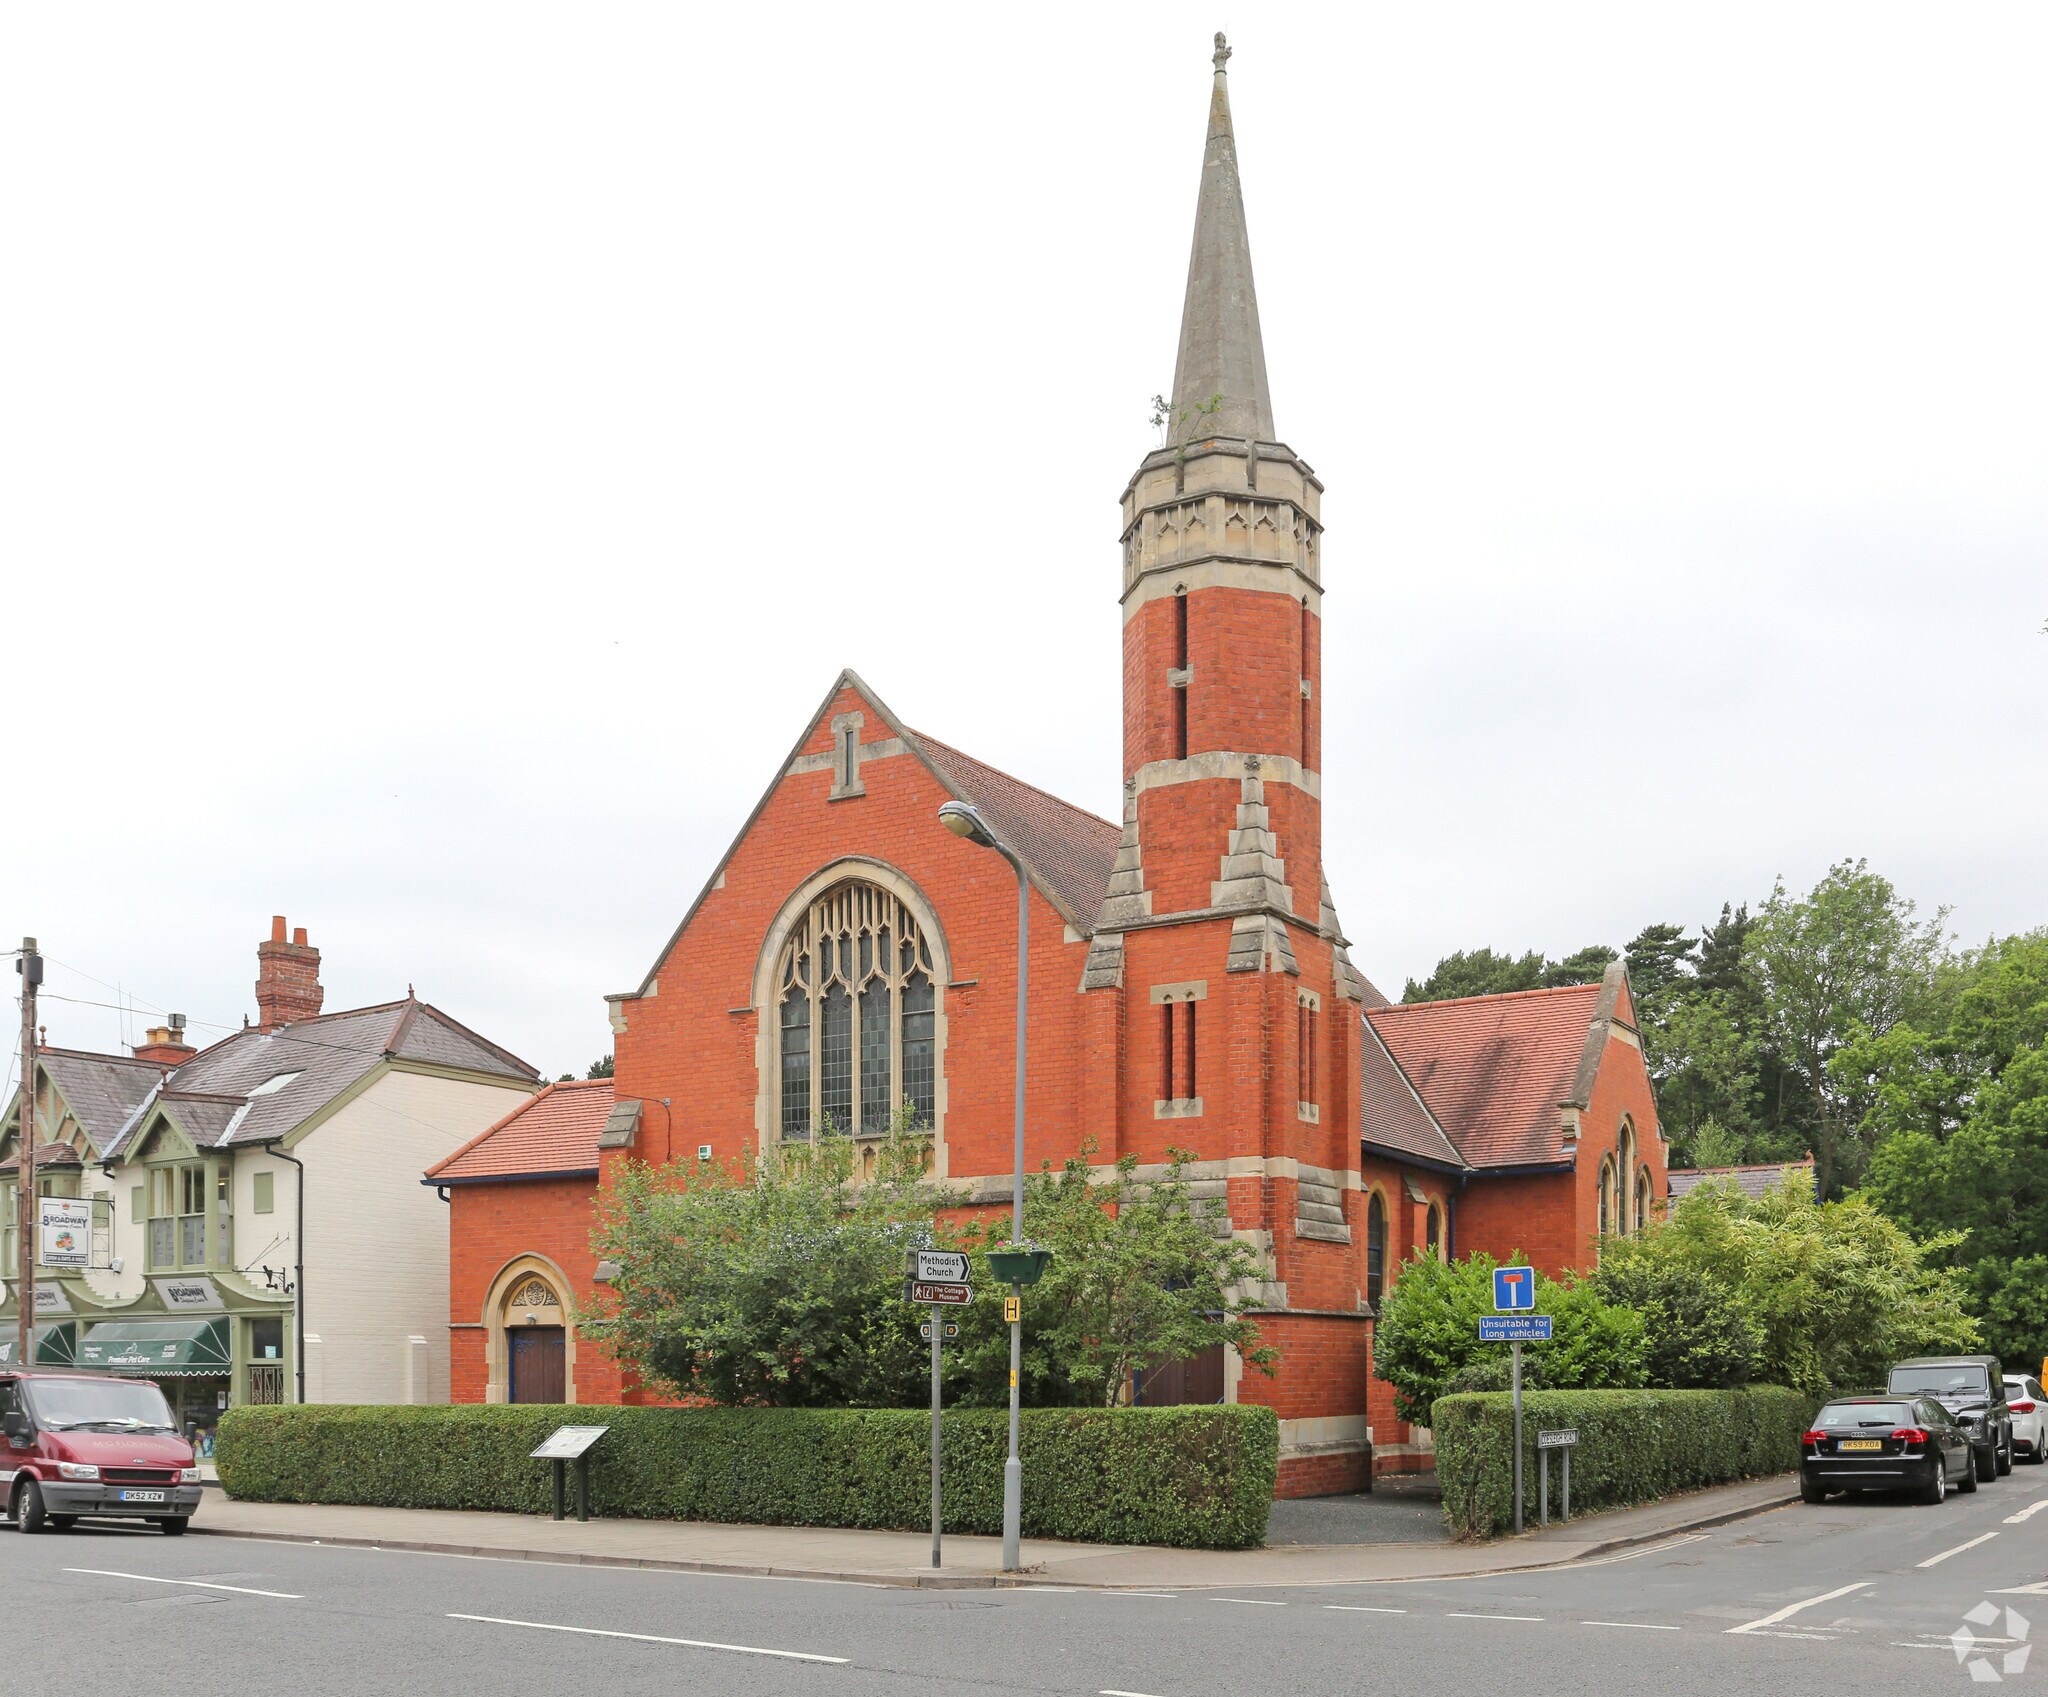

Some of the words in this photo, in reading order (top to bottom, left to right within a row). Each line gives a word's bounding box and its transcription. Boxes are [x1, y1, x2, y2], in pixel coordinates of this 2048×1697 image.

[43, 1215, 88, 1229] BROADWAY
[920, 1255, 959, 1266] Methodist
[926, 1266, 954, 1276] Church
[167, 1287, 208, 1303] BROADWAY
[944, 1287, 964, 1295] Cottage
[939, 1293, 960, 1301] Museum
[1006, 1299, 1017, 1319] H
[1482, 1319, 1530, 1328] Unsuitable
[1535, 1319, 1548, 1327] for
[1485, 1329, 1505, 1339] long
[1509, 1329, 1546, 1338] vehicles
[107, 1355, 128, 1364] Premier
[127, 1355, 138, 1363] Pet
[137, 1355, 151, 1363] Care
[125, 1491, 146, 1500] DK52
[147, 1492, 163, 1500] XZW
